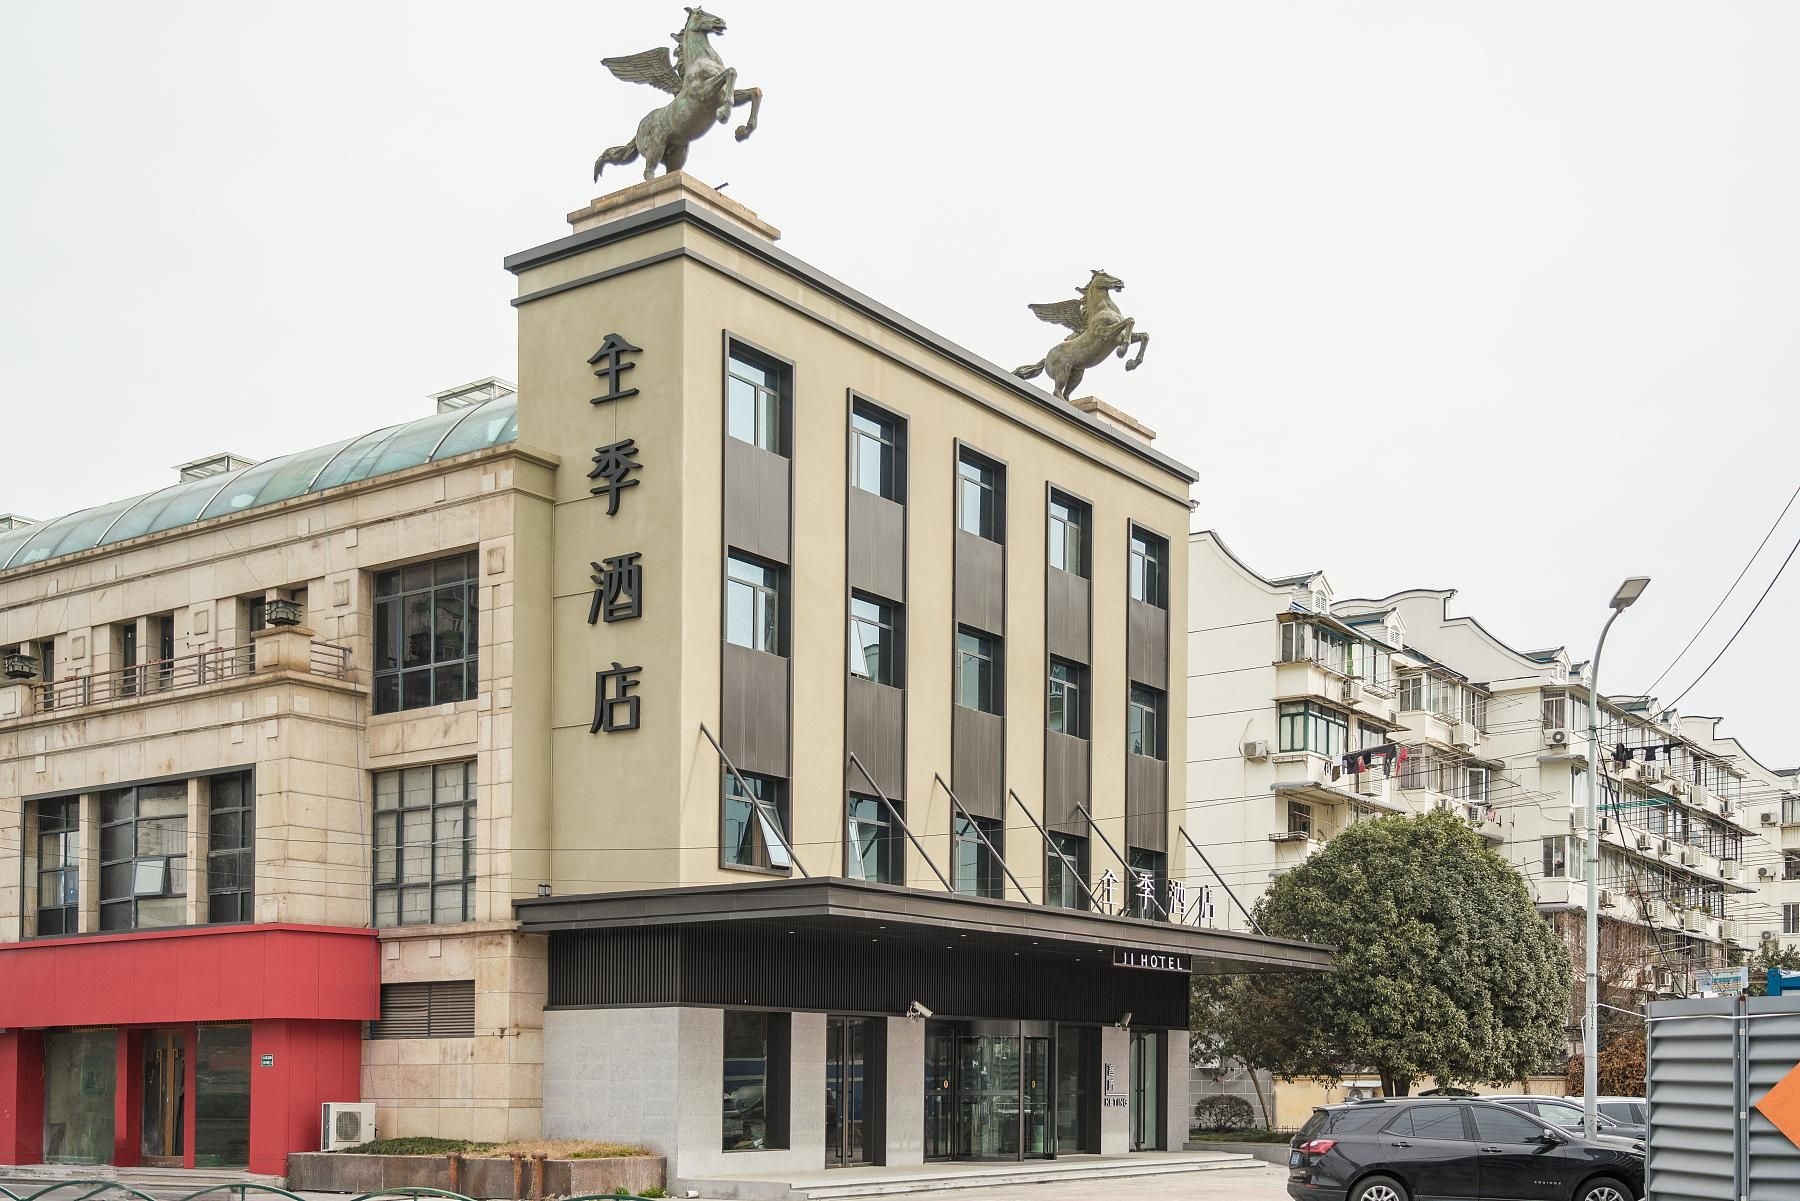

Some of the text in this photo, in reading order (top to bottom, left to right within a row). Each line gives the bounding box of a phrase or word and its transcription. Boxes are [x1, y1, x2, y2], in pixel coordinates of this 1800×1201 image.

[587, 333, 643, 735] 全季酒店
[1101, 869, 1215, 919] 全季酒店
[1123, 952, 1182, 970] JI HOTEL
